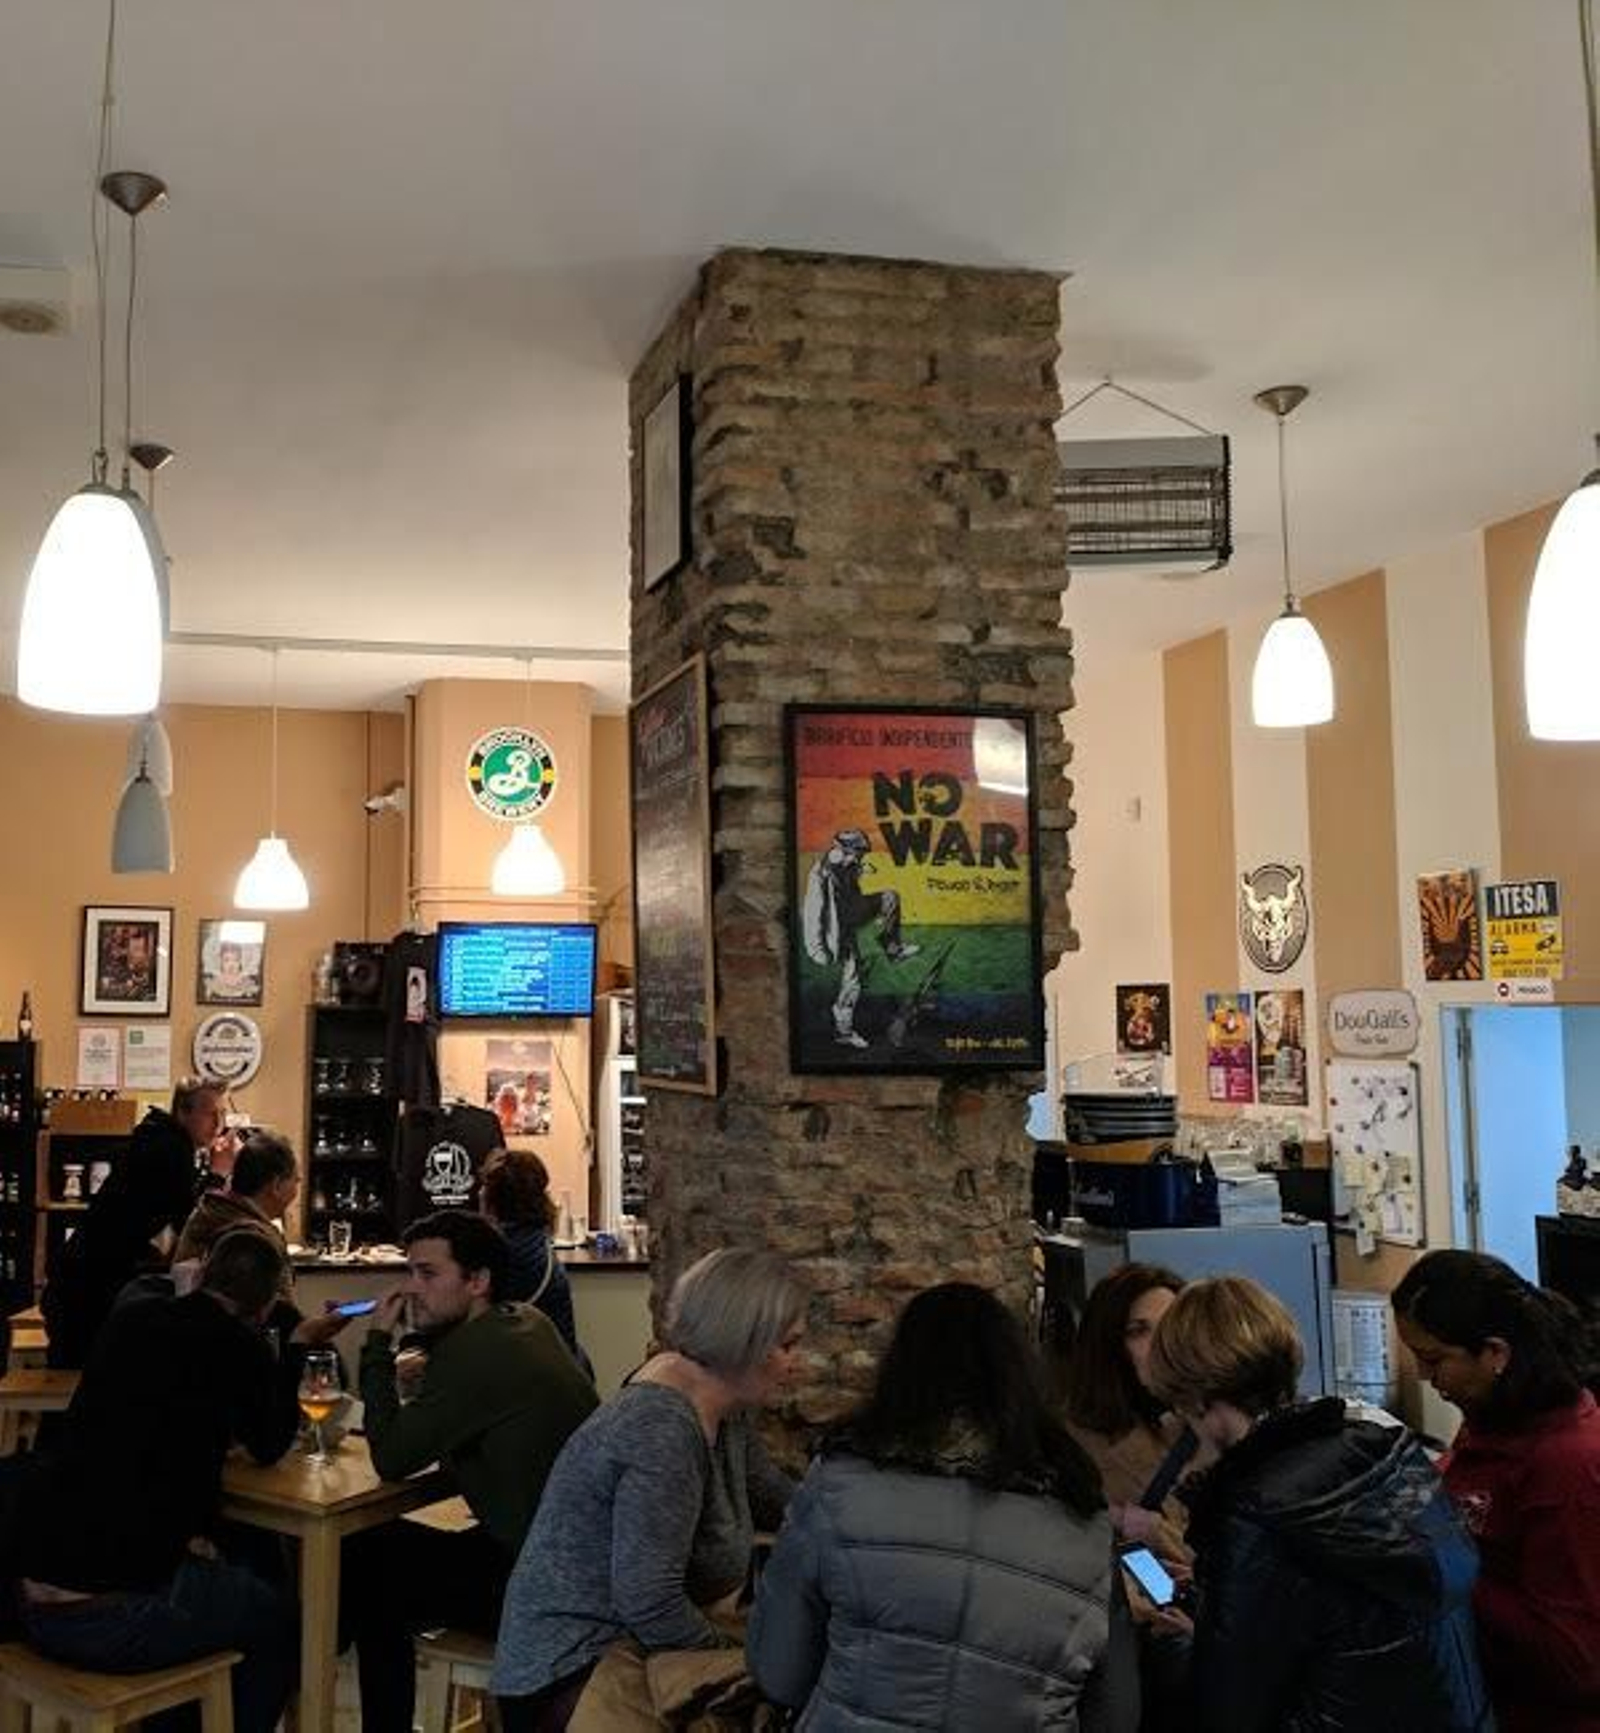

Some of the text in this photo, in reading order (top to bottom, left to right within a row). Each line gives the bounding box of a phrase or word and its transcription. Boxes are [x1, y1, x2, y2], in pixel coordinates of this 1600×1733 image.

[872, 769, 963, 817] NO
[879, 819, 1019, 869] WAR
[1493, 883, 1549, 917] ITESA
